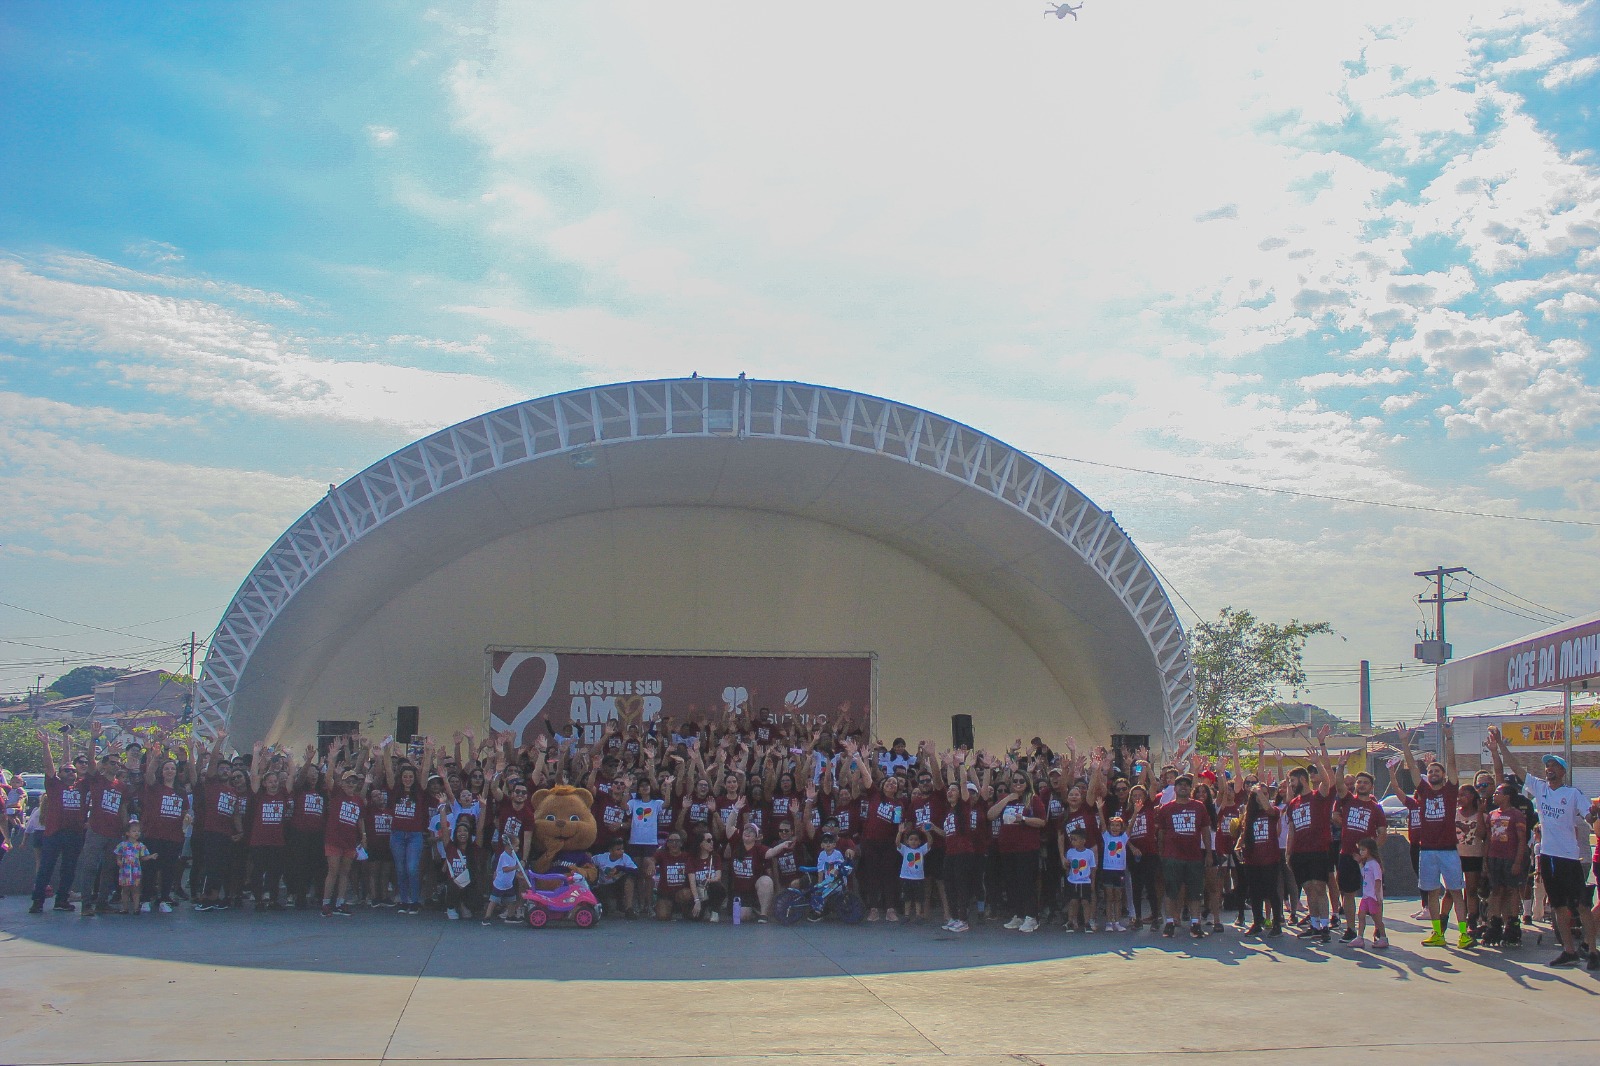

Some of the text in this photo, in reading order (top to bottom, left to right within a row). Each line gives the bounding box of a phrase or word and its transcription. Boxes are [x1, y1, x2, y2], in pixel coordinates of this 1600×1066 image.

[1508, 643, 1535, 690] CAFÉ
[1539, 644, 1555, 683] DA
[570, 680, 662, 695] MOSTRE SEU
